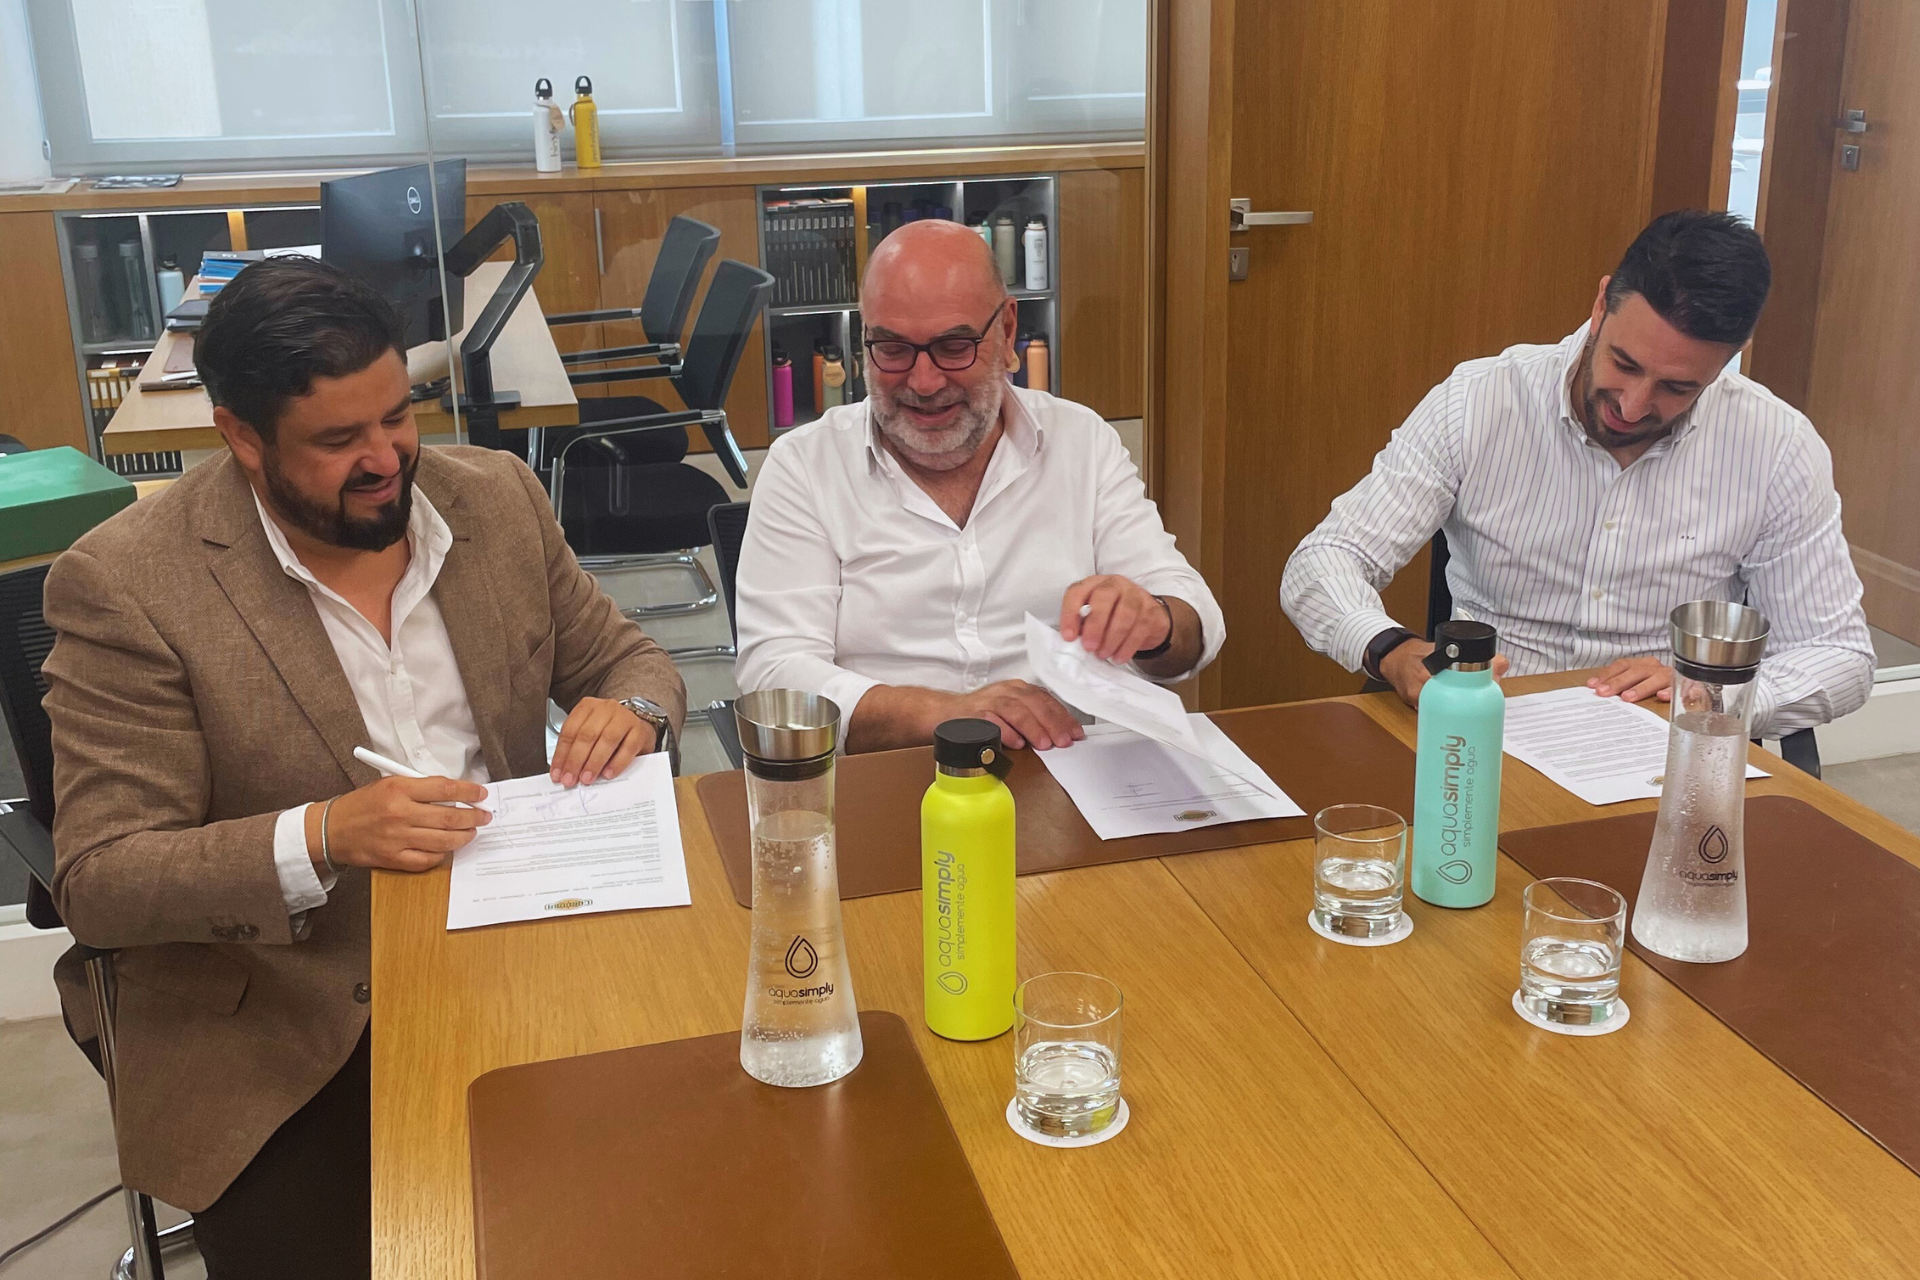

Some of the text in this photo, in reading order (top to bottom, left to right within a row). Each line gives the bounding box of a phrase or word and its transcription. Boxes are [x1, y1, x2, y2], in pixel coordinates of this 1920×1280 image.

[1440, 735, 1467, 856] aquasimply
[1463, 746, 1478, 848] simplemente agua
[934, 850, 955, 967] aquasimply
[956, 863, 968, 961] simplemente agua
[1679, 869, 1739, 881] aquasimply
[768, 982, 834, 999] aquasimply
